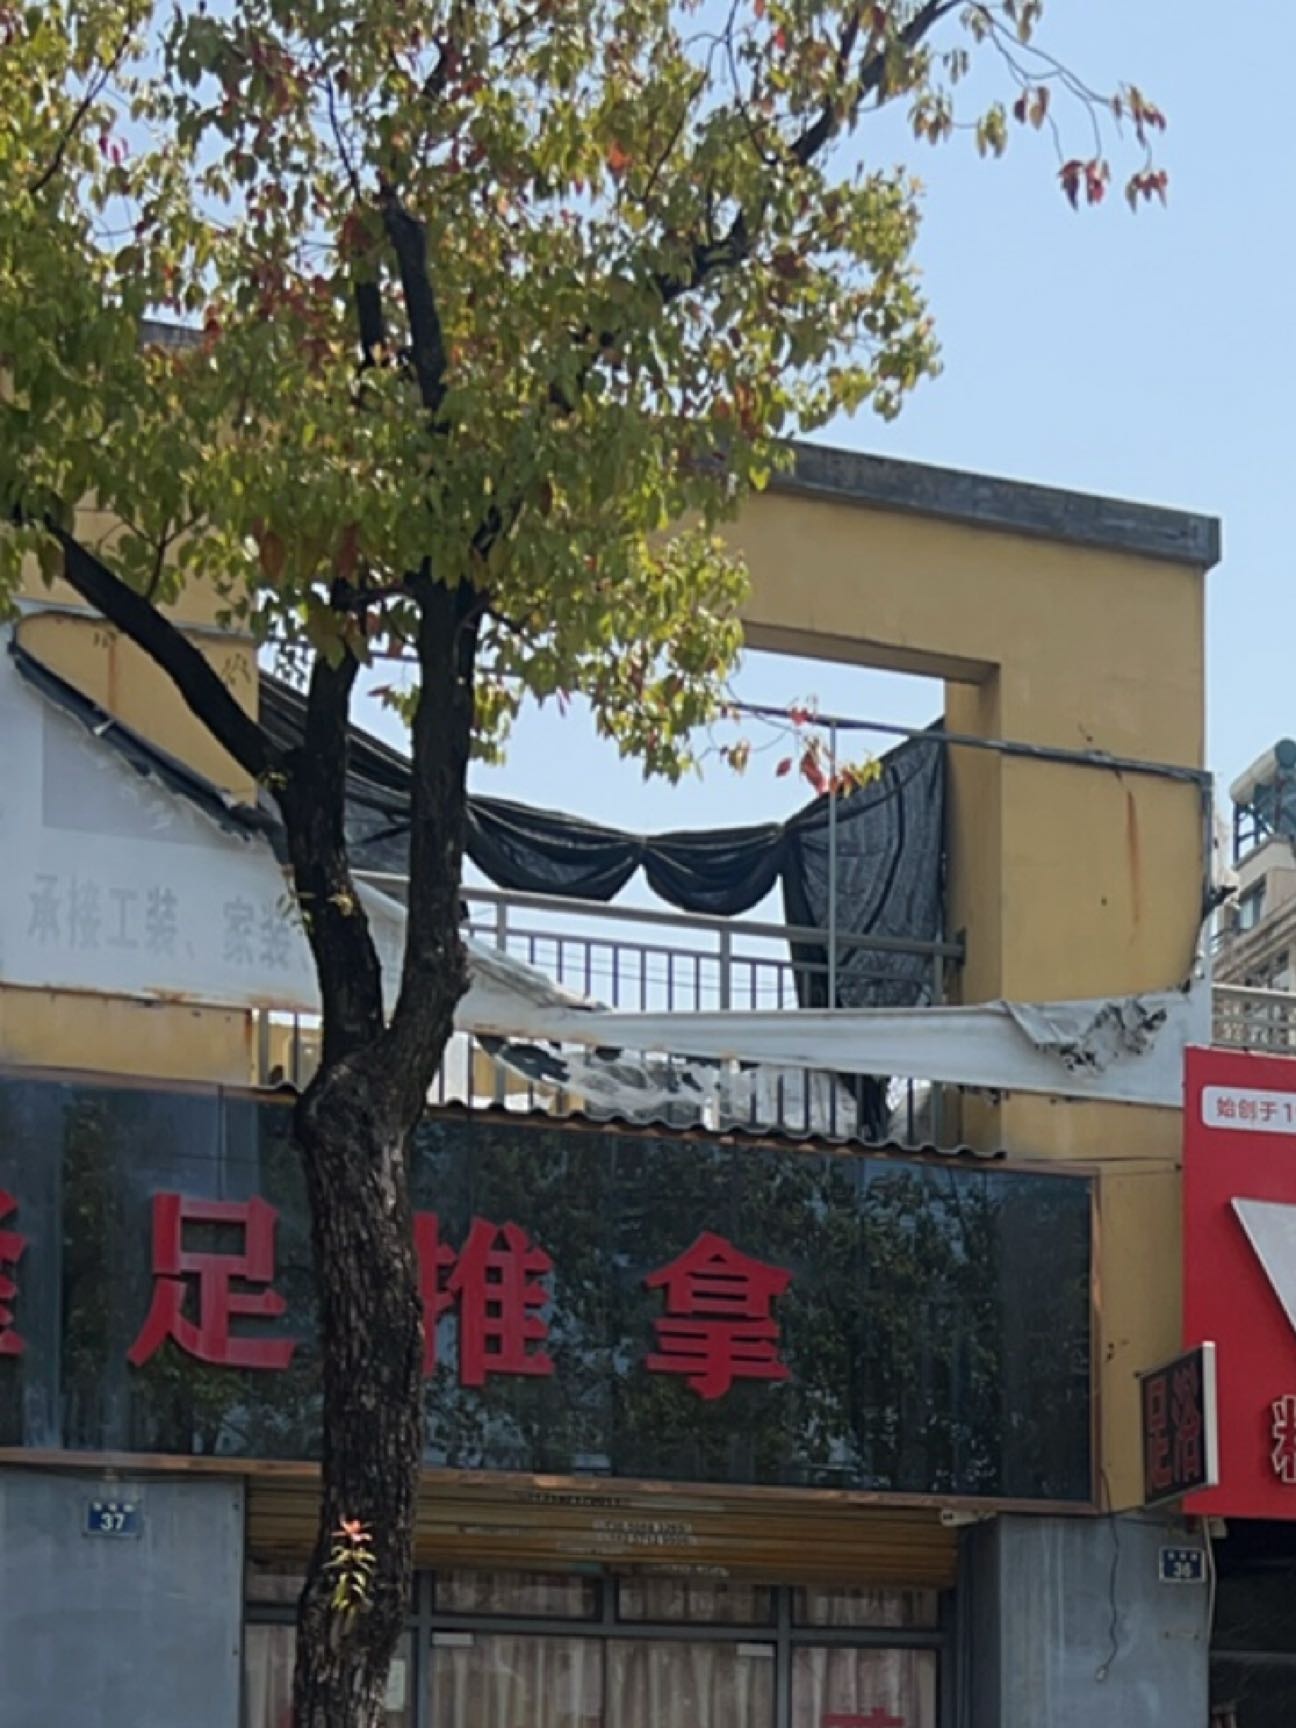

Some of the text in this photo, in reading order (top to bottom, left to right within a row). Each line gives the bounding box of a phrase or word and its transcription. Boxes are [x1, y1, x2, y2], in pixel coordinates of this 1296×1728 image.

[0, 1187, 793, 1401] 足推拿
[100, 1512, 125, 1532] 37
